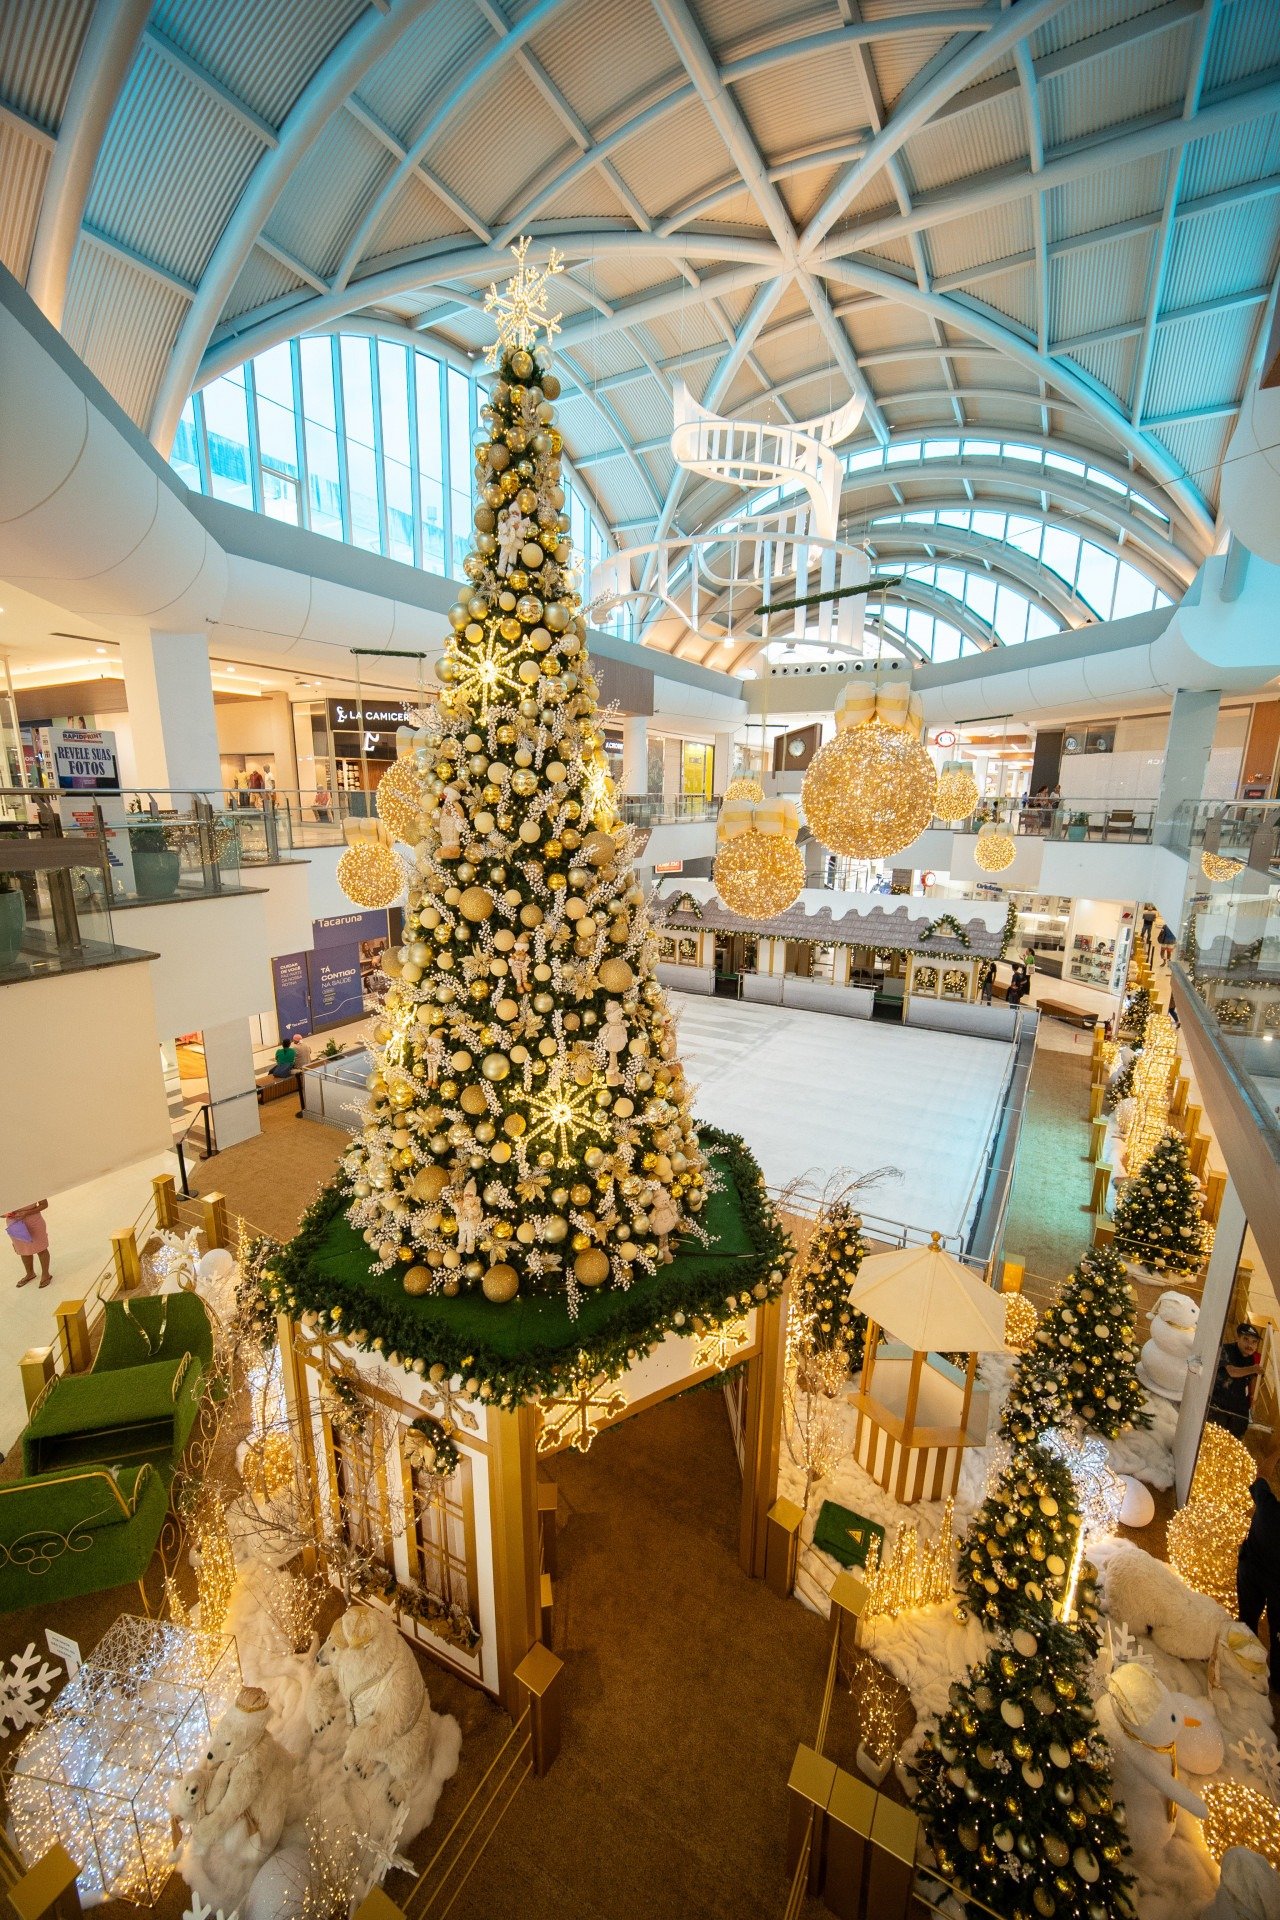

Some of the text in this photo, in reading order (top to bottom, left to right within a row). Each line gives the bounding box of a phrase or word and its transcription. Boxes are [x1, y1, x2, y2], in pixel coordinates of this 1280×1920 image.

[349, 710, 410, 721] LA CAMICER
[62, 732, 102, 740] RAPIDPRINT
[57, 746, 112, 761] REVELE SUAS
[68, 760, 106, 775] FOTOS
[318, 914, 363, 928] Tacaruna
[321, 969, 356, 981] CONTIGO
[332, 977, 351, 986] SAÚDE
